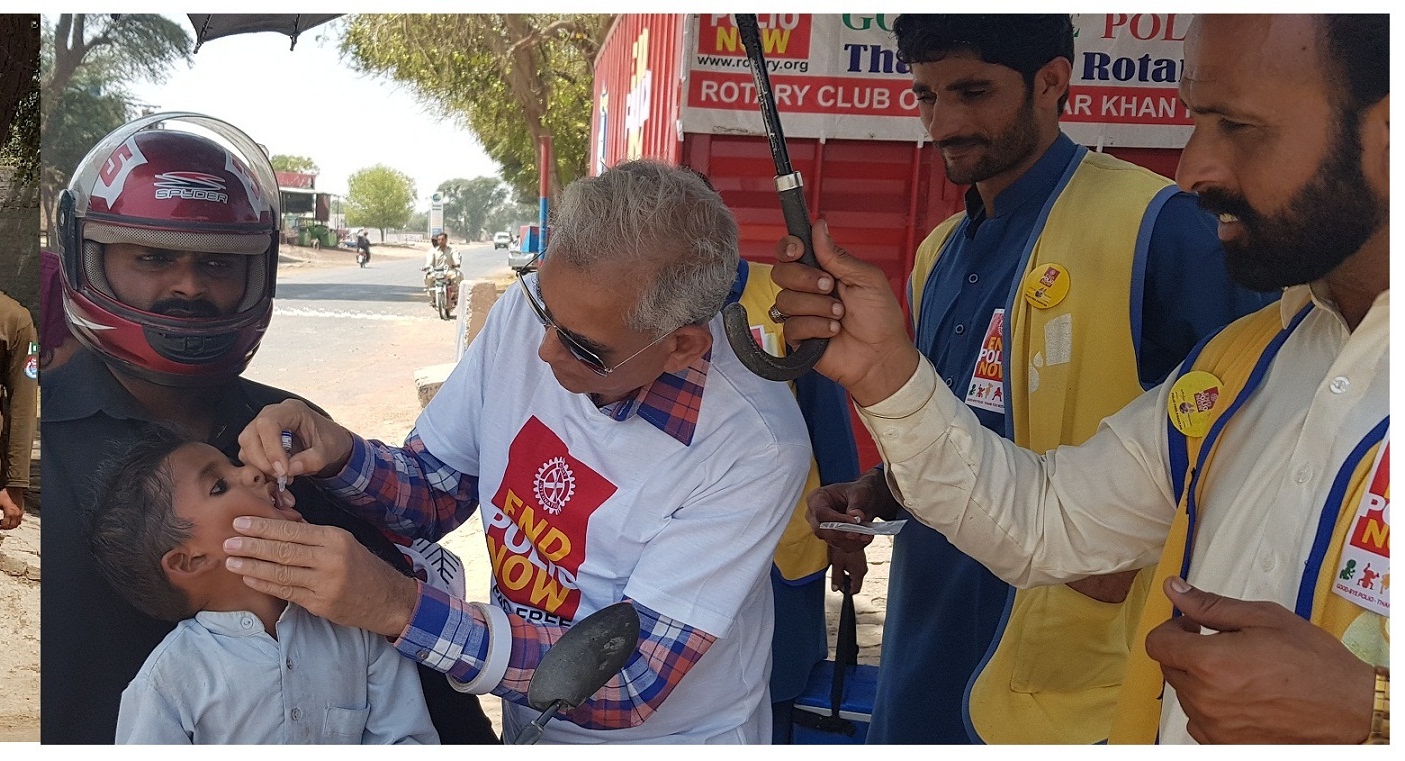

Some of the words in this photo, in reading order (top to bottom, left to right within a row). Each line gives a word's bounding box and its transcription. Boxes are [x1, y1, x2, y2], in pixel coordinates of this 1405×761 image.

[716, 26, 791, 54] NW
[697, 56, 809, 72] www.rory.org
[701, 80, 811, 106] ROTRY
[817, 85, 890, 108] CLUB
[1063, 94, 1092, 116] AR
[1101, 95, 1176, 118] KHAN
[155, 188, 229, 204] SPYDER
[502, 488, 572, 562] END
